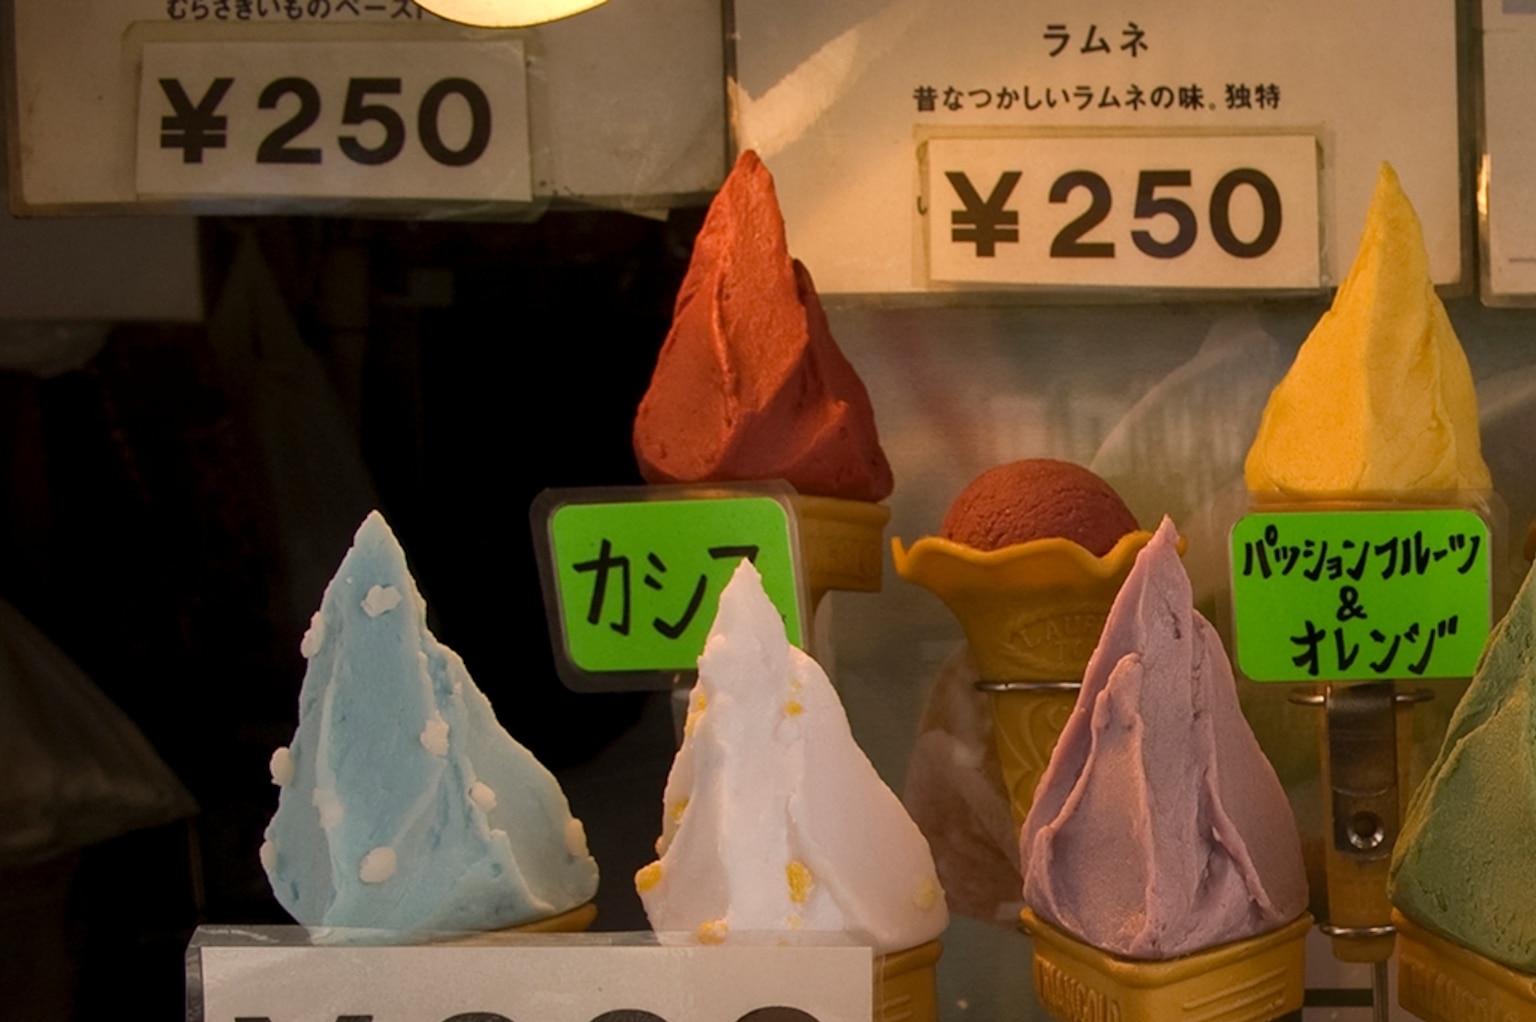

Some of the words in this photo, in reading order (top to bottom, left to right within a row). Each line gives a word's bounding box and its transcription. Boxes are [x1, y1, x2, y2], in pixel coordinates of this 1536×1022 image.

[1042, 23, 1150, 58] ラムネ
[158, 77, 493, 168] ¥250
[944, 167, 1283, 259] ¥250
[1242, 524, 1481, 581] パッションフルーツ
[1336, 585, 1367, 621] &
[1290, 615, 1458, 676] オレンジ
